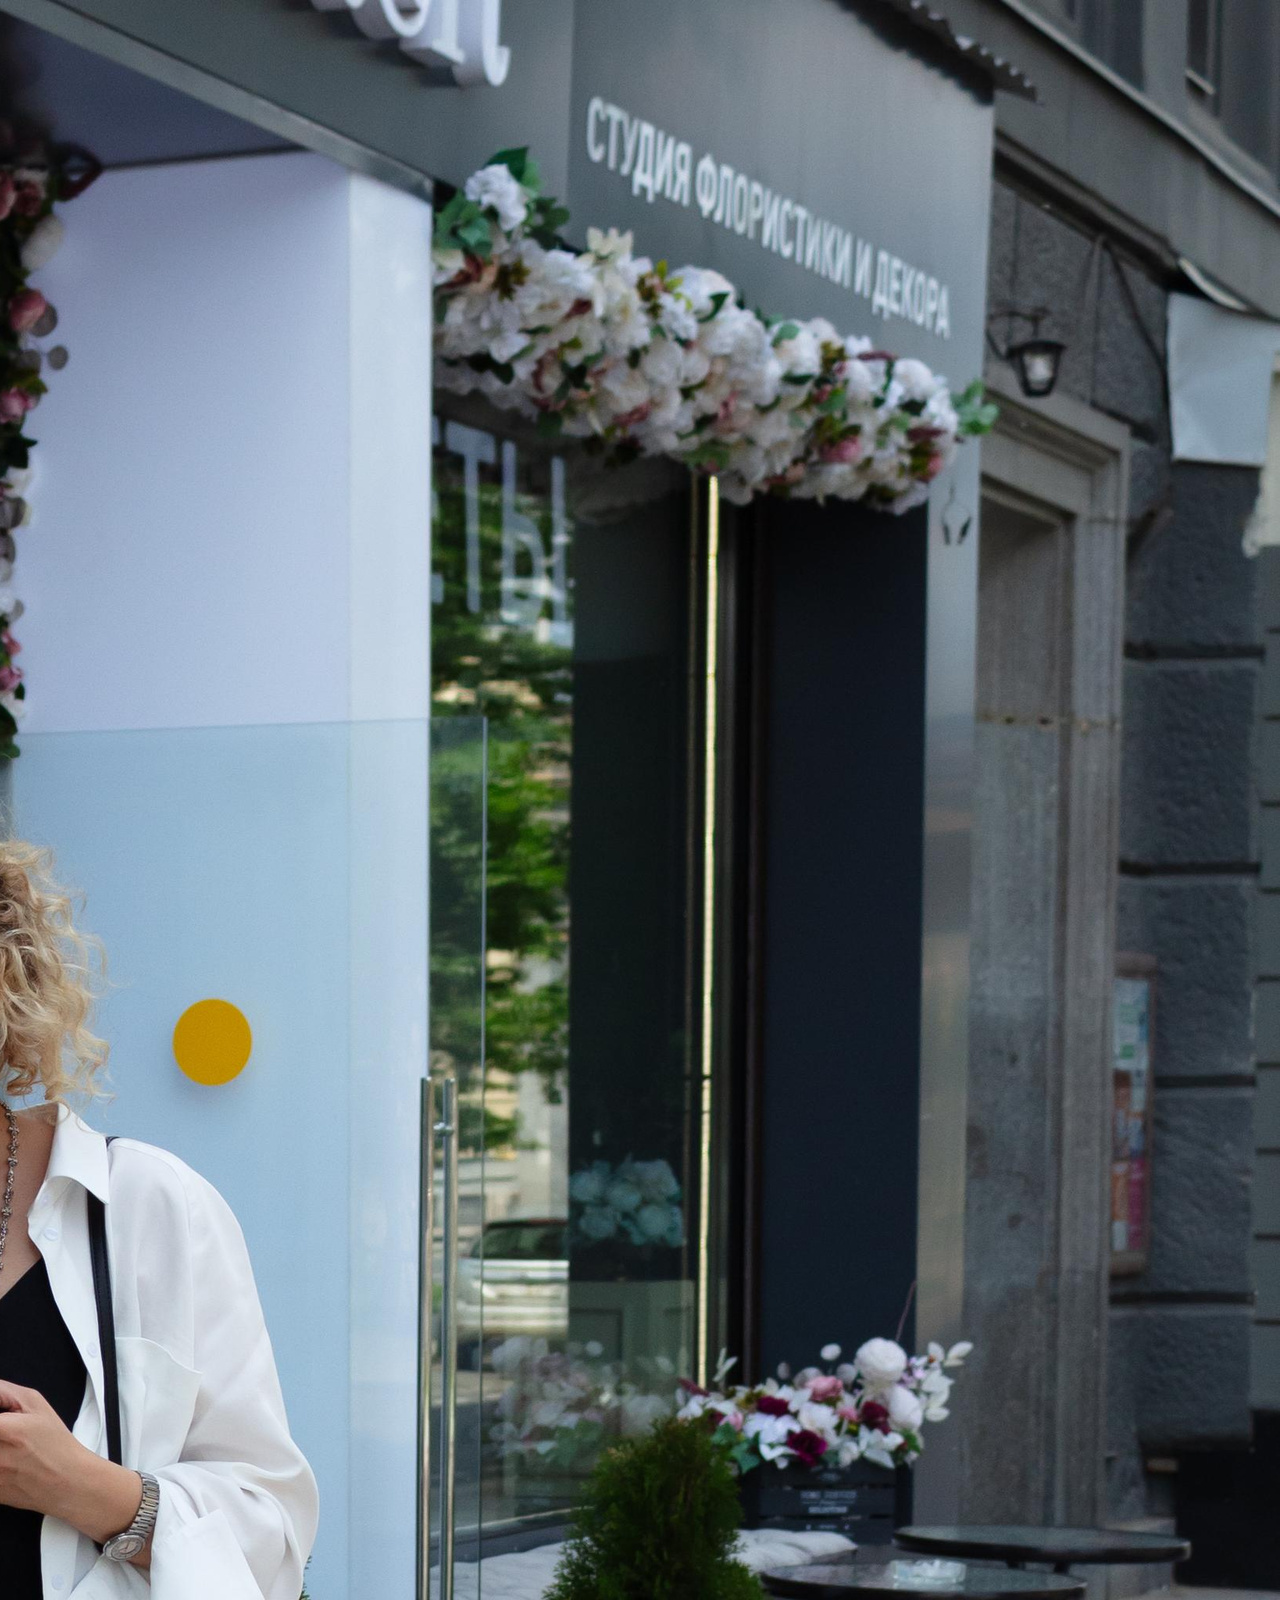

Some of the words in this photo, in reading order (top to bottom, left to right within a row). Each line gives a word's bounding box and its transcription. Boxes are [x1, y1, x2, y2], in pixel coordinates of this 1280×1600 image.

[587, 97, 692, 206] СТУДИЯ
[695, 153, 852, 289] ФЛОРИСТИКИ
[854, 239, 873, 298] И
[873, 250, 951, 340] ДЕКОРА
[431, 415, 566, 624] ТЫ
